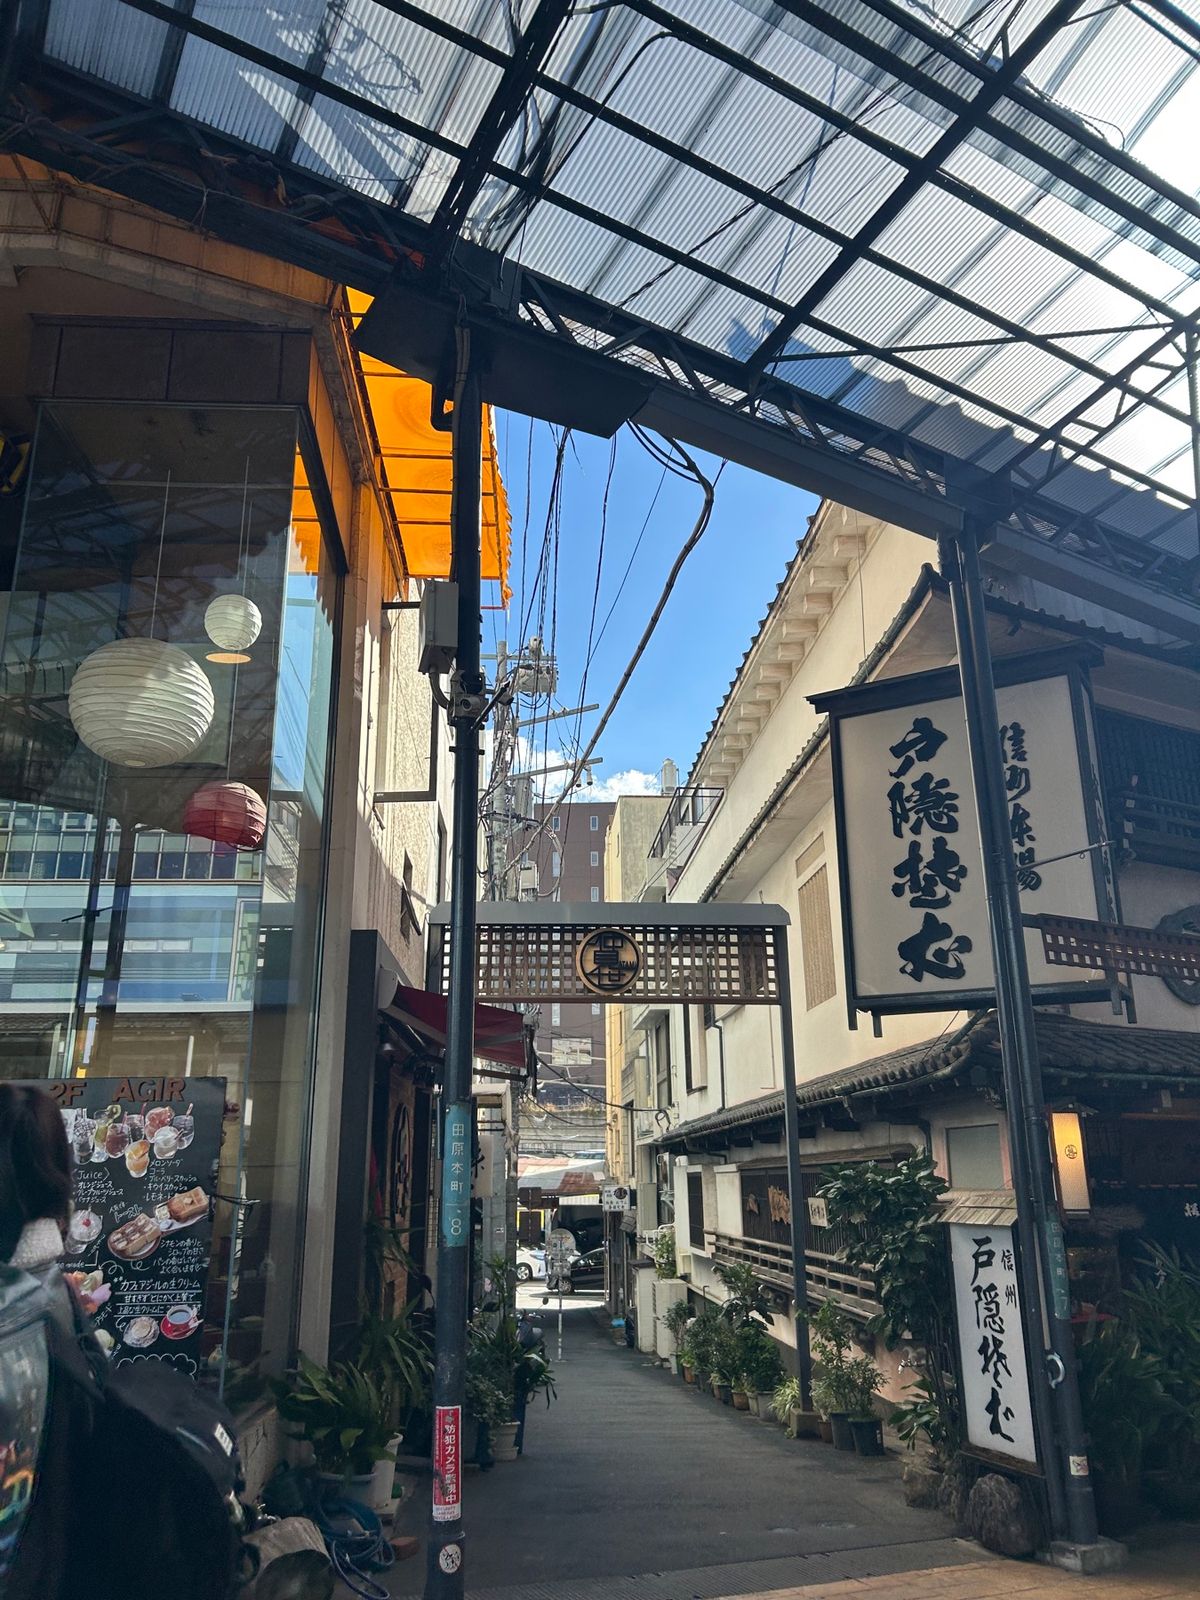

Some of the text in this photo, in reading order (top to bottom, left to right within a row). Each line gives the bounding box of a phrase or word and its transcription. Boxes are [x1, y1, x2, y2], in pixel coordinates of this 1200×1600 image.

[111, 1077, 187, 1103] AGIR
[450, 1123, 465, 1194] 田原本町
[120, 1277, 201, 1292] カフェアジールの生クリーム
[1000, 1248, 1018, 1310] 信州
